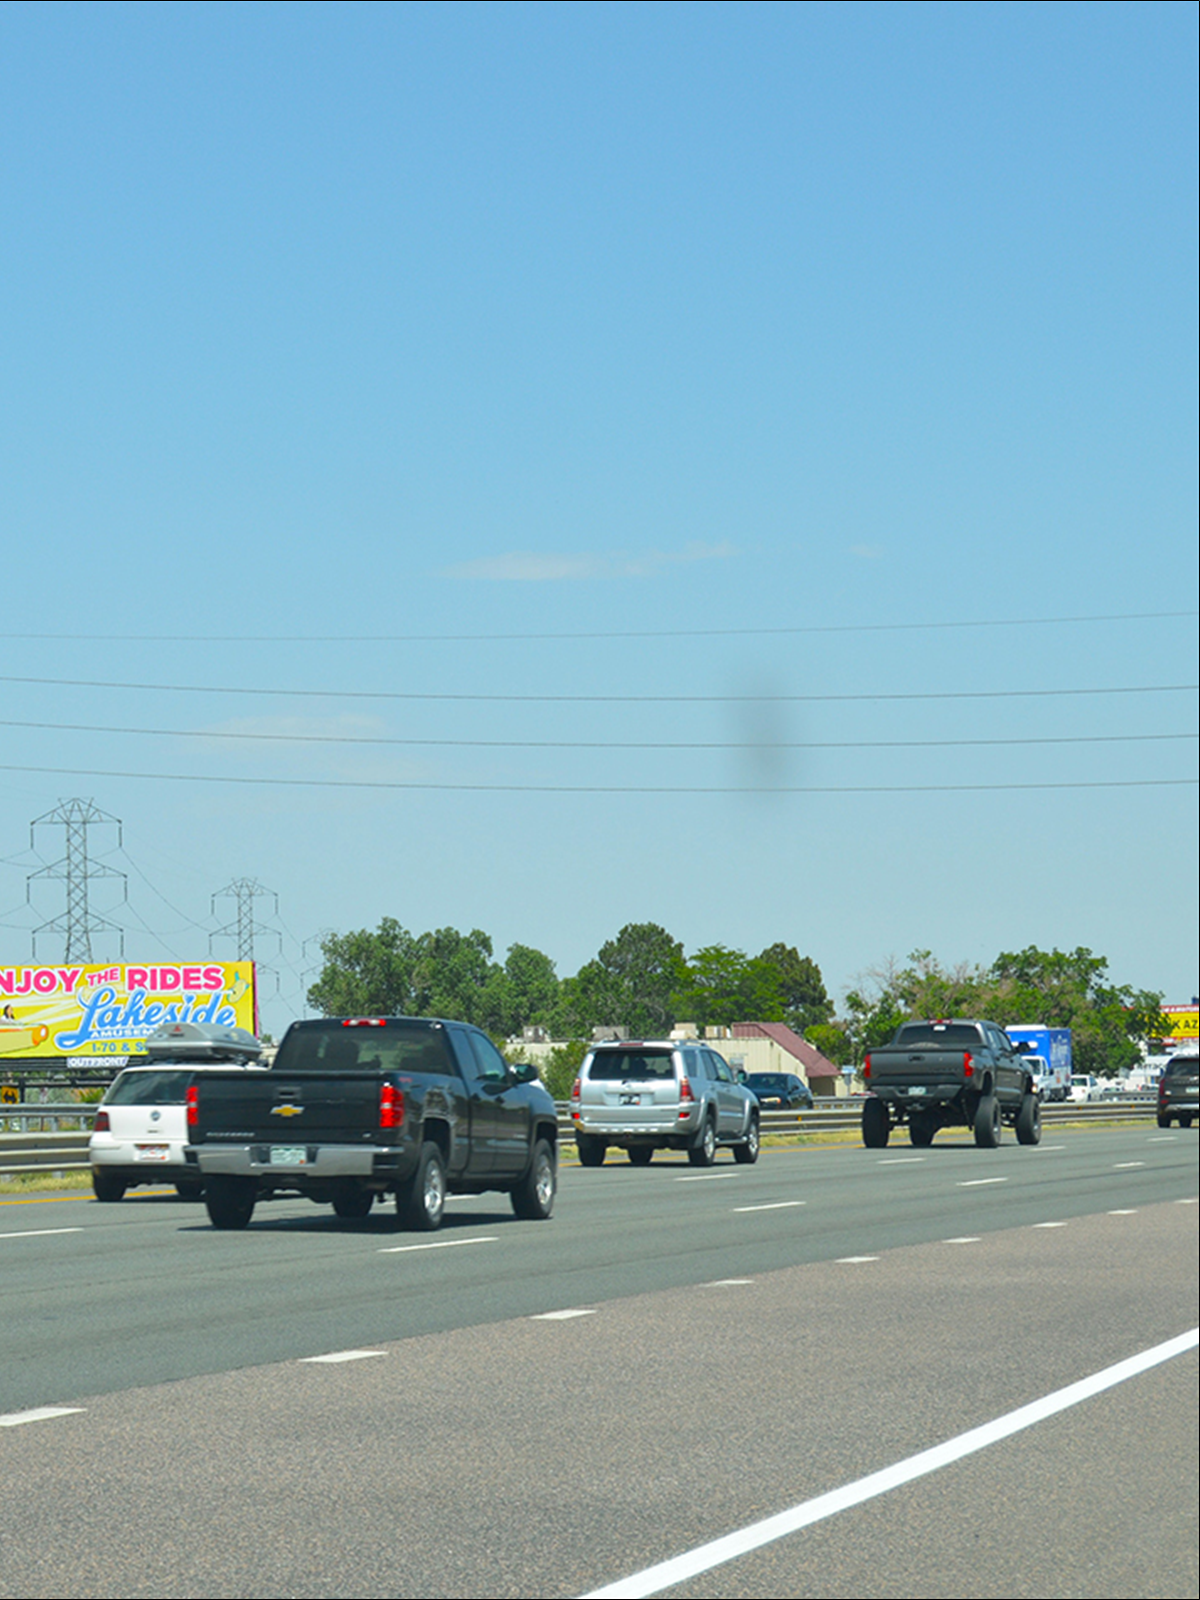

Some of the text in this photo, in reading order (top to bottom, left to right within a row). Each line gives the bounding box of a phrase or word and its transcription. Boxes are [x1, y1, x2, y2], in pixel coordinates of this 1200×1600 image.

[87, 968, 119, 986] THE
[127, 966, 223, 990] RIDES
[55, 986, 235, 1049] Lakeside
[90, 1028, 154, 1039] AMUSEM
[92, 1042, 117, 1053] I-70
[121, 1042, 131, 1052] &
[68, 1056, 127, 1068] OUTFRONT
